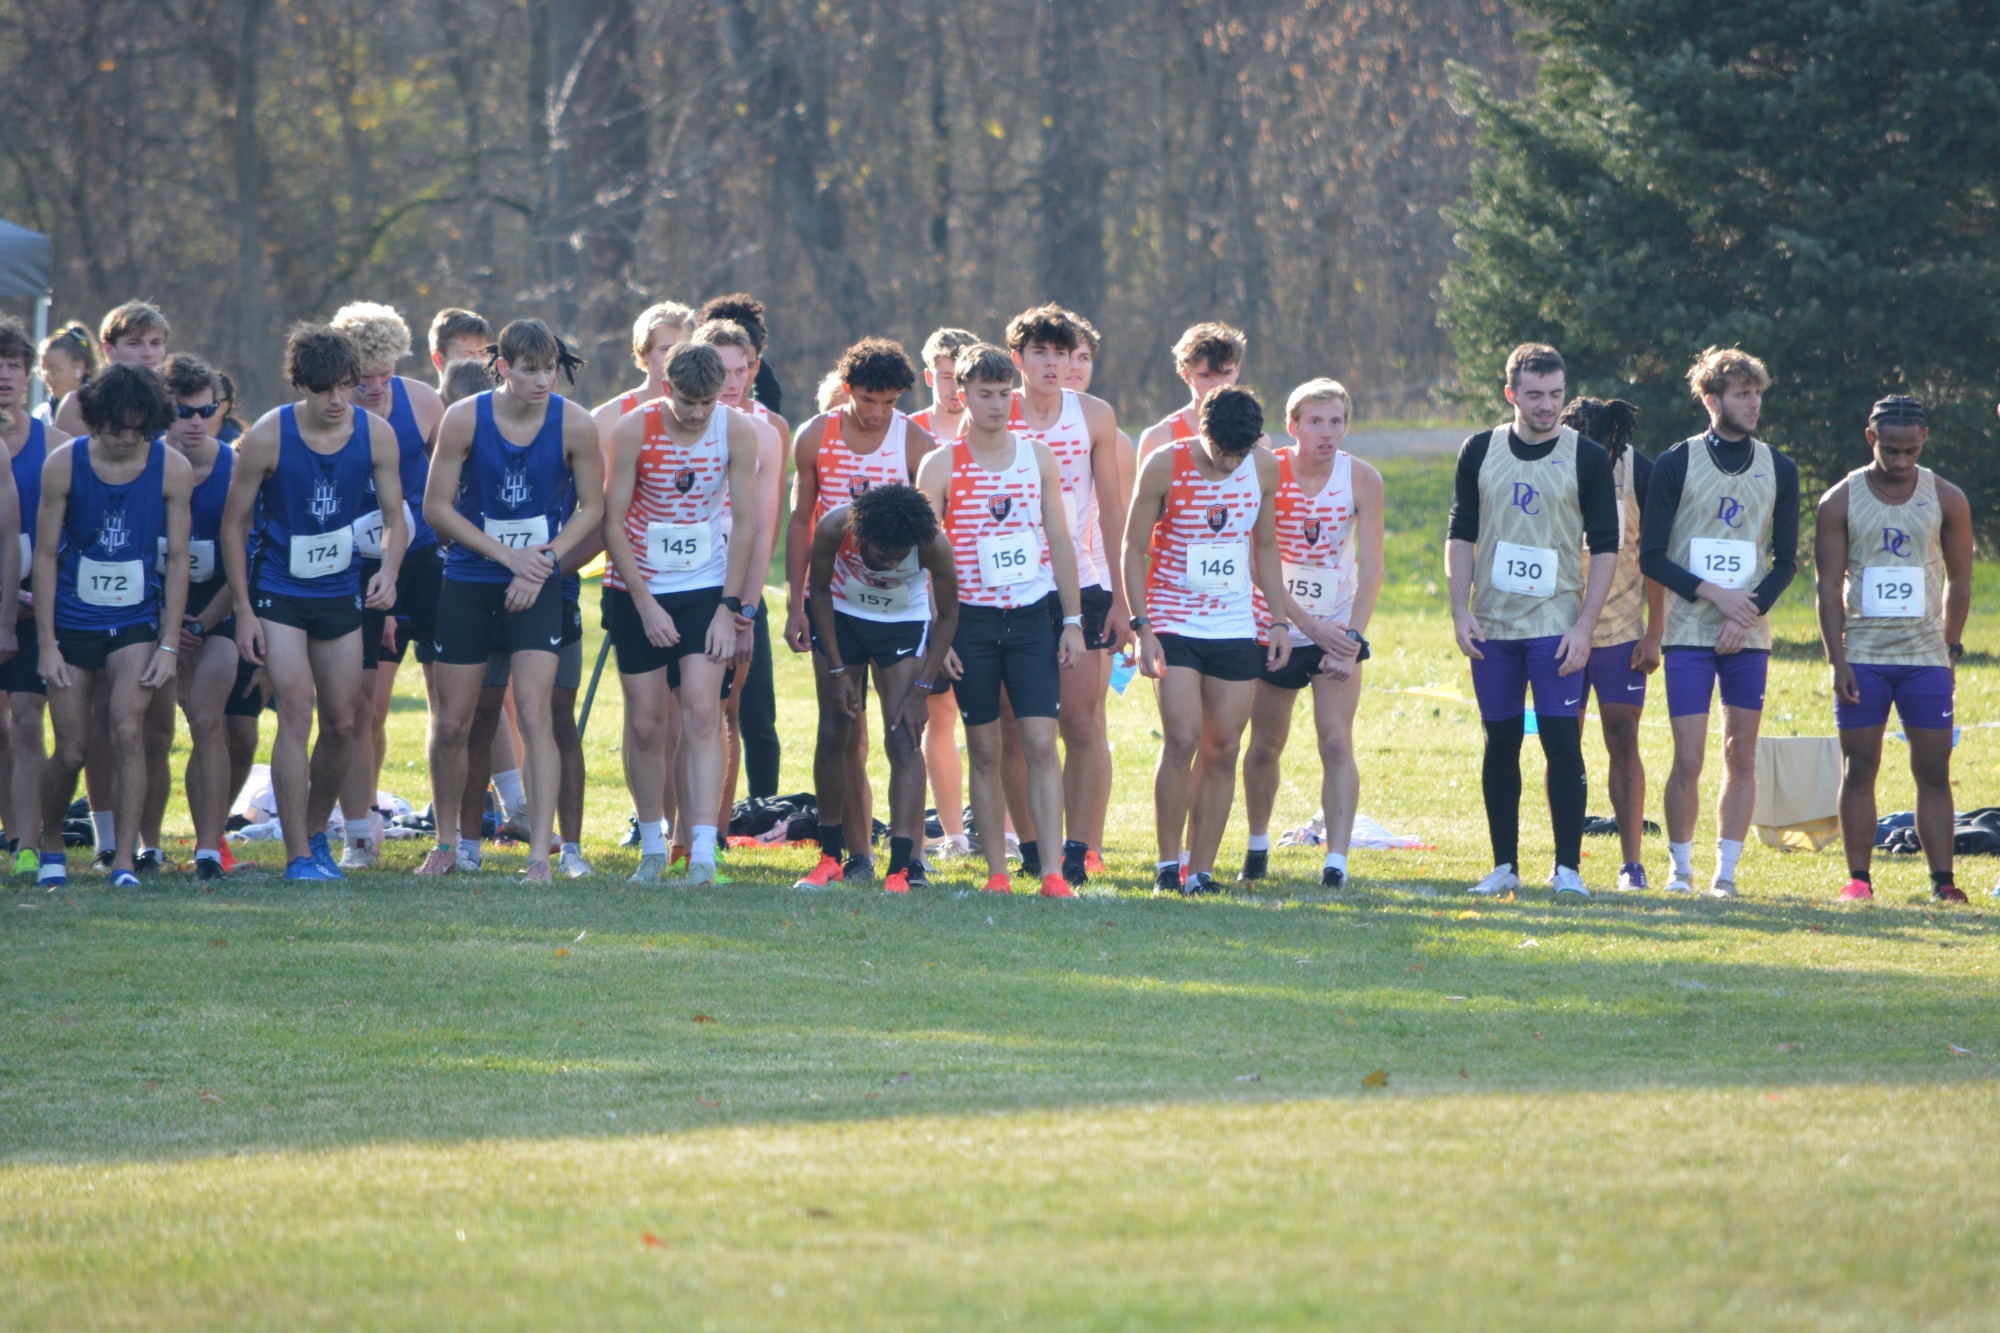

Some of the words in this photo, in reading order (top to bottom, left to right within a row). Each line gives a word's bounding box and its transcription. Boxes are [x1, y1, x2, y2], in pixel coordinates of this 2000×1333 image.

[1511, 482, 1540, 515] DC
[1716, 496, 1744, 529] DC
[366, 526, 383, 545] 17
[498, 532, 532, 548] 177
[1881, 527, 1911, 558] DC
[307, 544, 339, 563] 174
[662, 538, 697, 555] 145
[992, 548, 1026, 569] 156
[1200, 559, 1235, 576] 146
[1705, 554, 1741, 572] 125
[1507, 559, 1542, 580] 130
[91, 575, 128, 591] 172
[1287, 579, 1323, 599] 153
[1876, 582, 1913, 600] 129
[858, 593, 893, 607] 157
